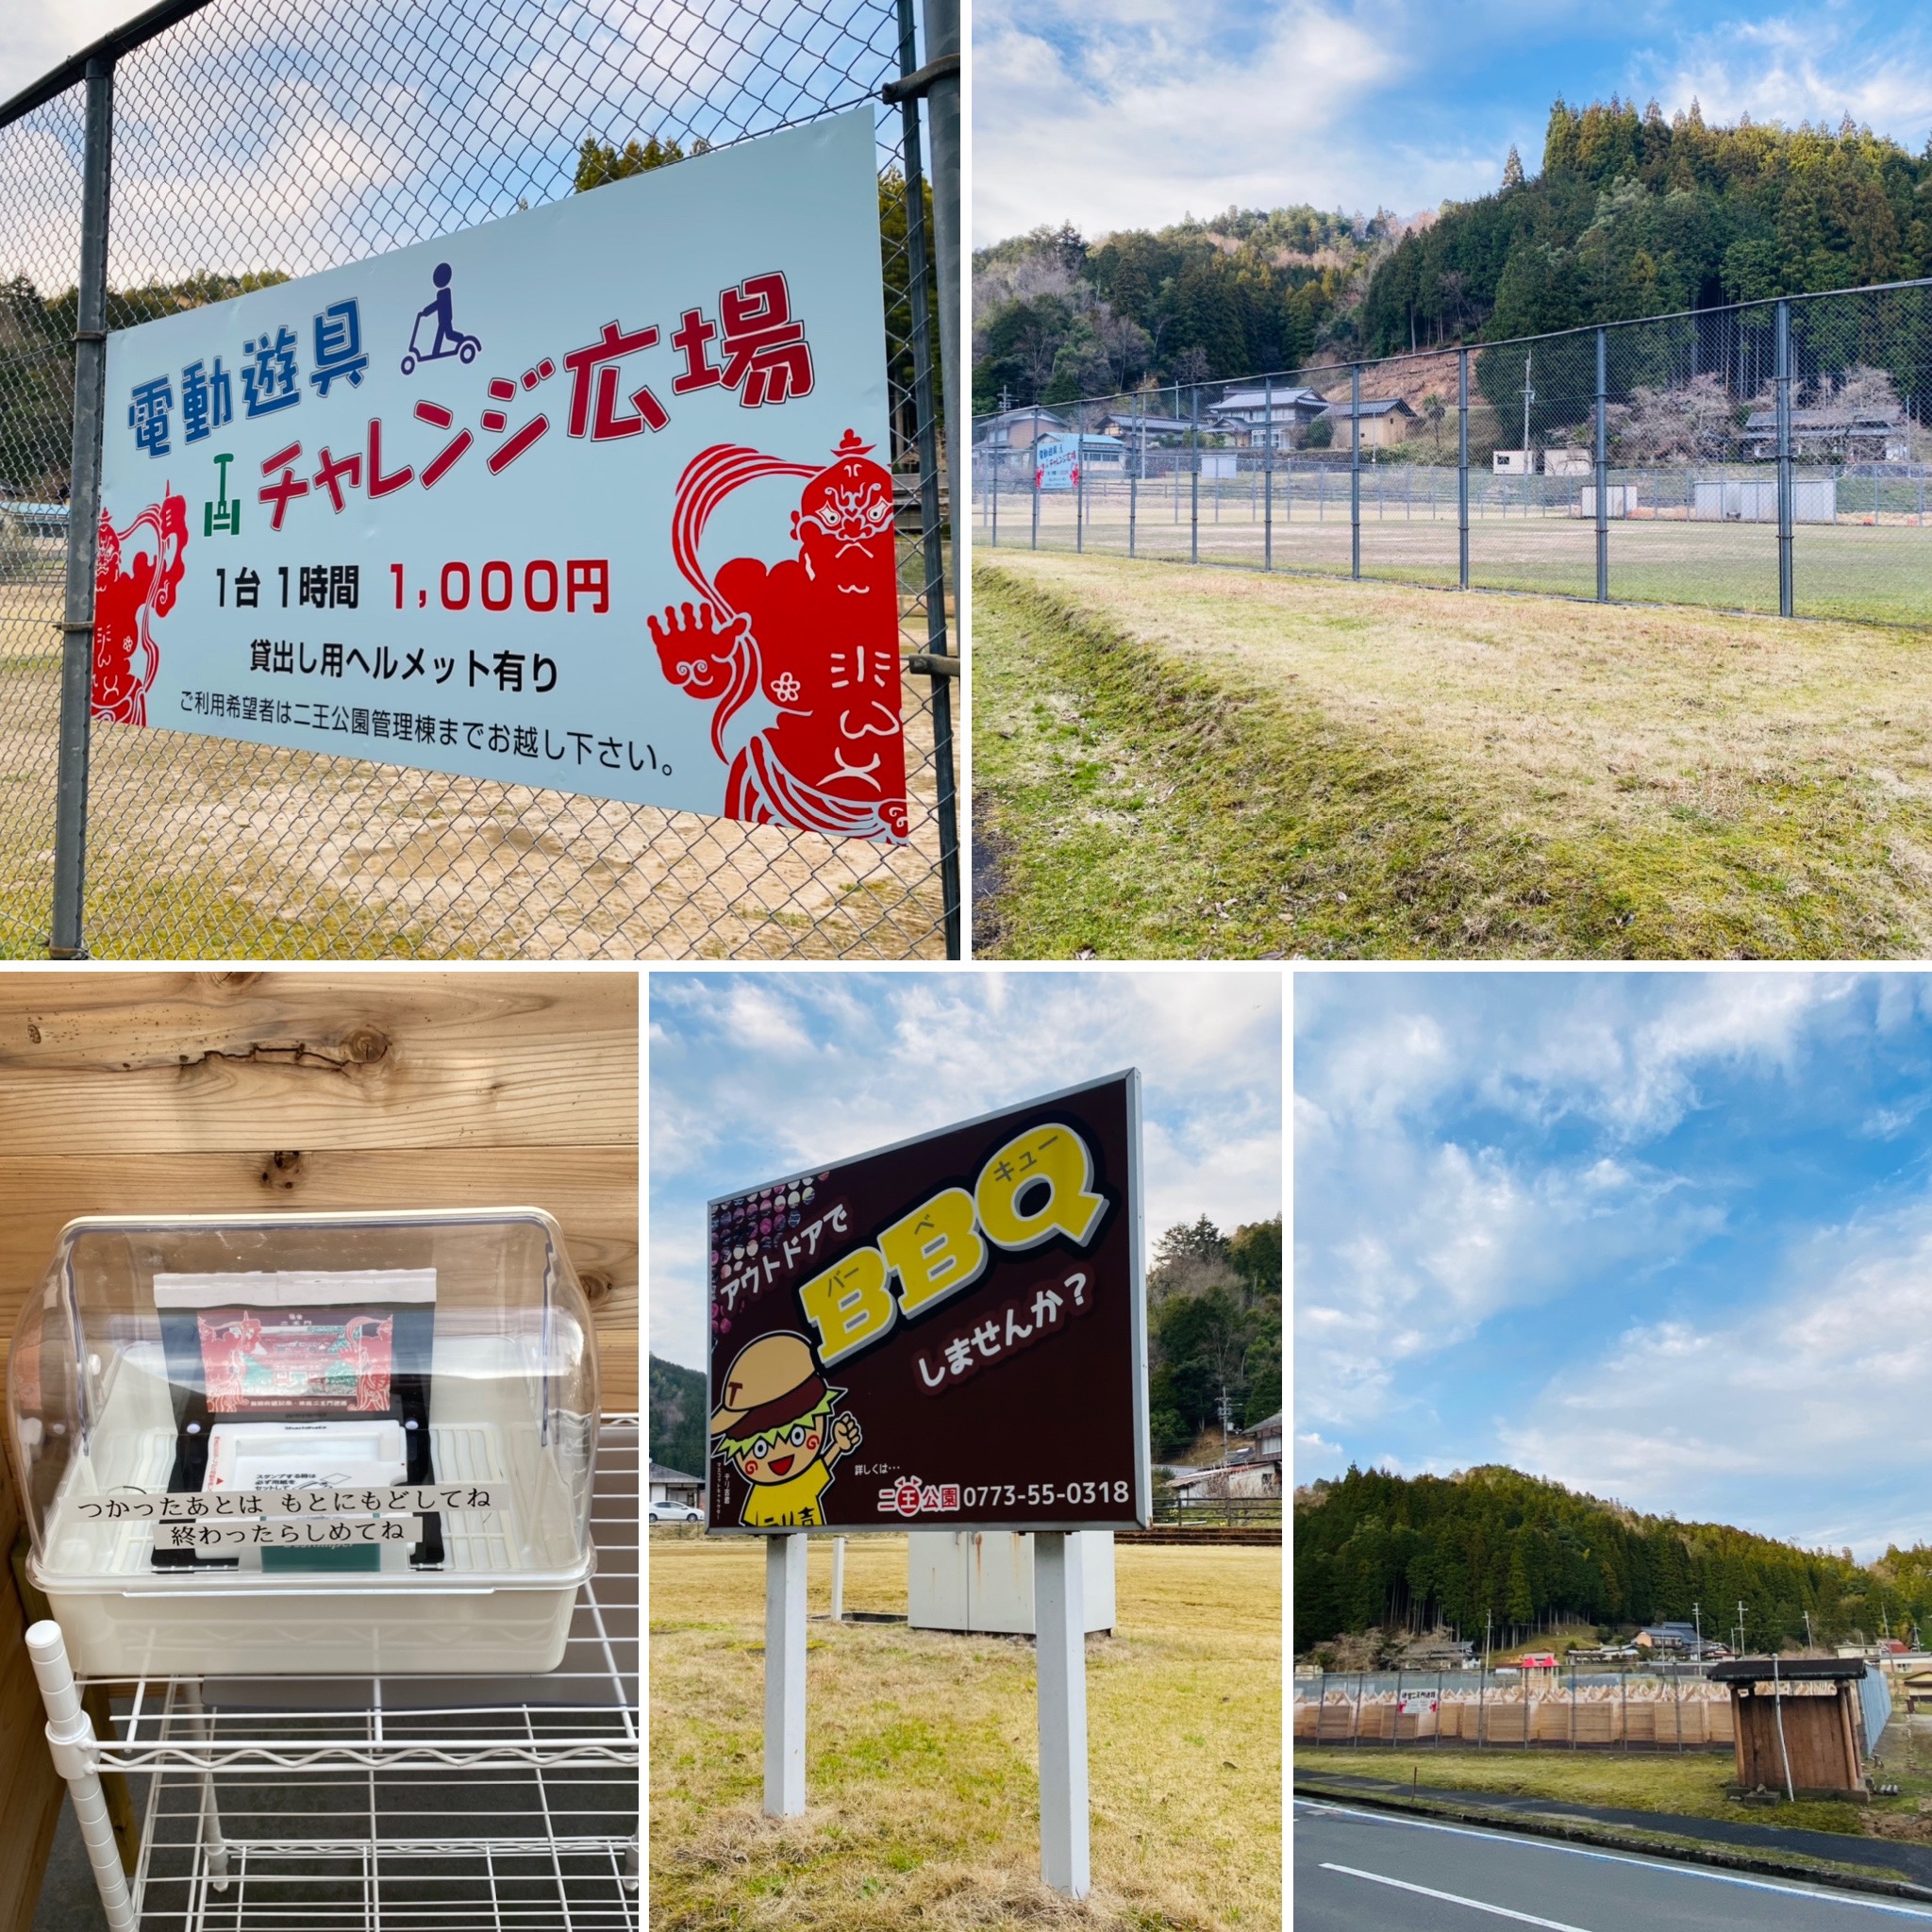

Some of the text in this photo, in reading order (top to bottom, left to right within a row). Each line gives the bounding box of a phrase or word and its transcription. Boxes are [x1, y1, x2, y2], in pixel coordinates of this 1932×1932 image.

[127, 297, 369, 458] 電動遊具
[258, 270, 815, 531] チャレンジ広場
[390, 558, 610, 614] 1,000円
[250, 638, 558, 693] 貸出し用ヘルメット有り
[179, 691, 673, 776] ご利用希望者は二王公園管理棟までお越し下さい。
[720, 1204, 848, 1311] アウトドアで
[798, 1123, 1109, 1368] BBQ
[77, 1488, 491, 1521] つかったあとは もとにもどしてね
[963, 1480, 1129, 1507] 0773-55-0318
[171, 1521, 405, 1547] 終わったらしめてね
